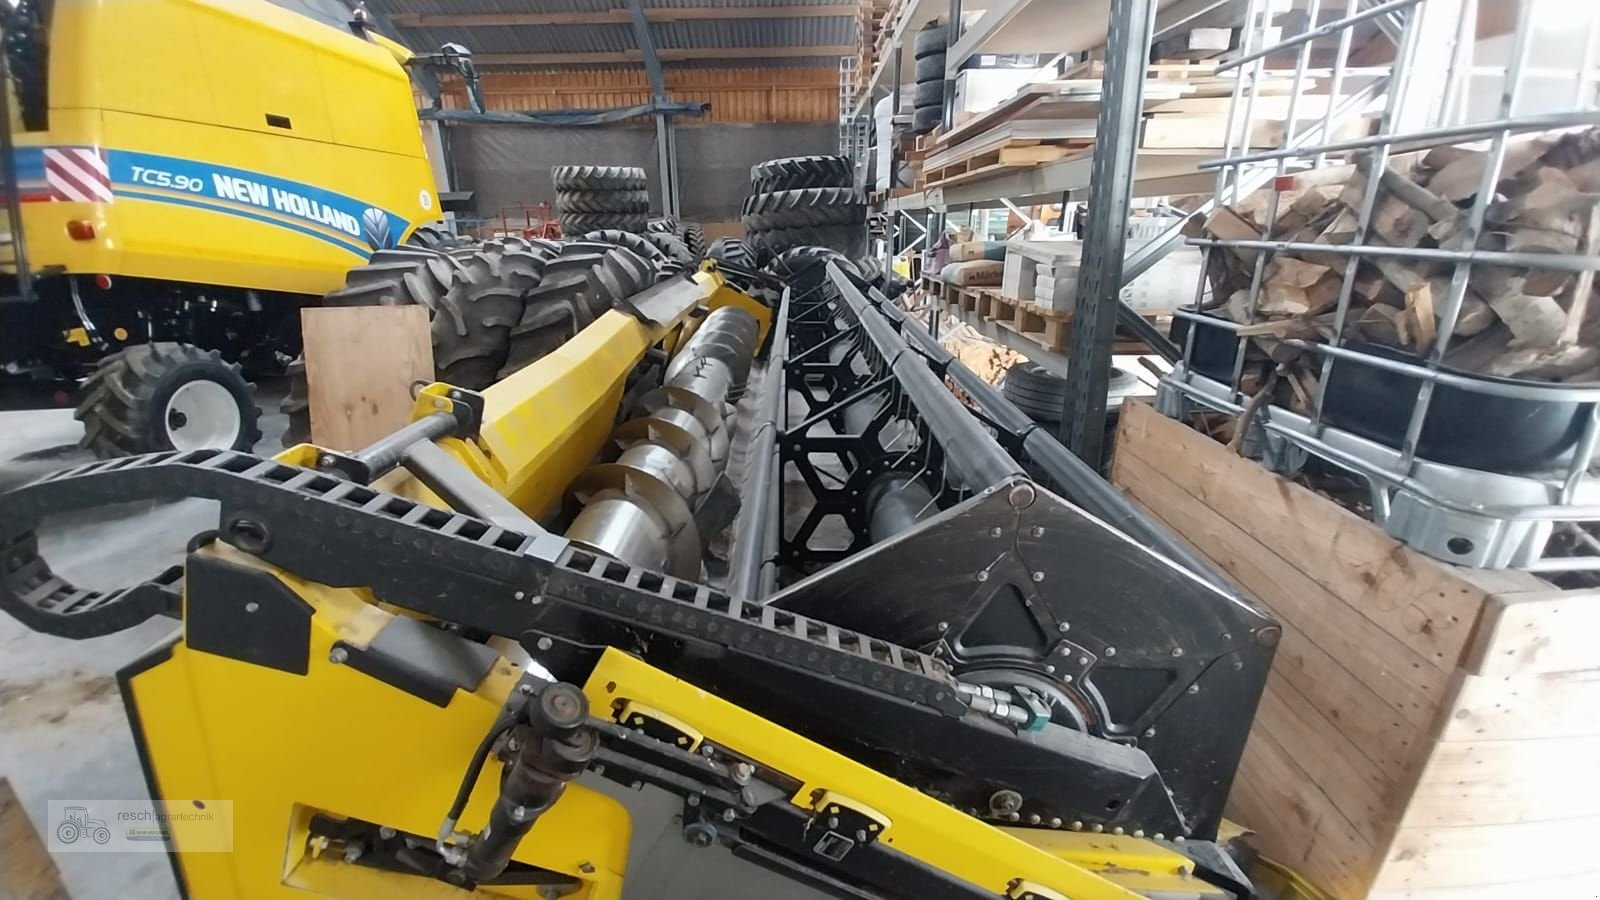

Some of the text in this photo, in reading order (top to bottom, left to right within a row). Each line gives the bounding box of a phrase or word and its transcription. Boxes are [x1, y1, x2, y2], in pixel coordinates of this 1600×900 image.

[131, 166, 203, 192] TC5.90
[212, 173, 361, 237] NEW HOLLAND
